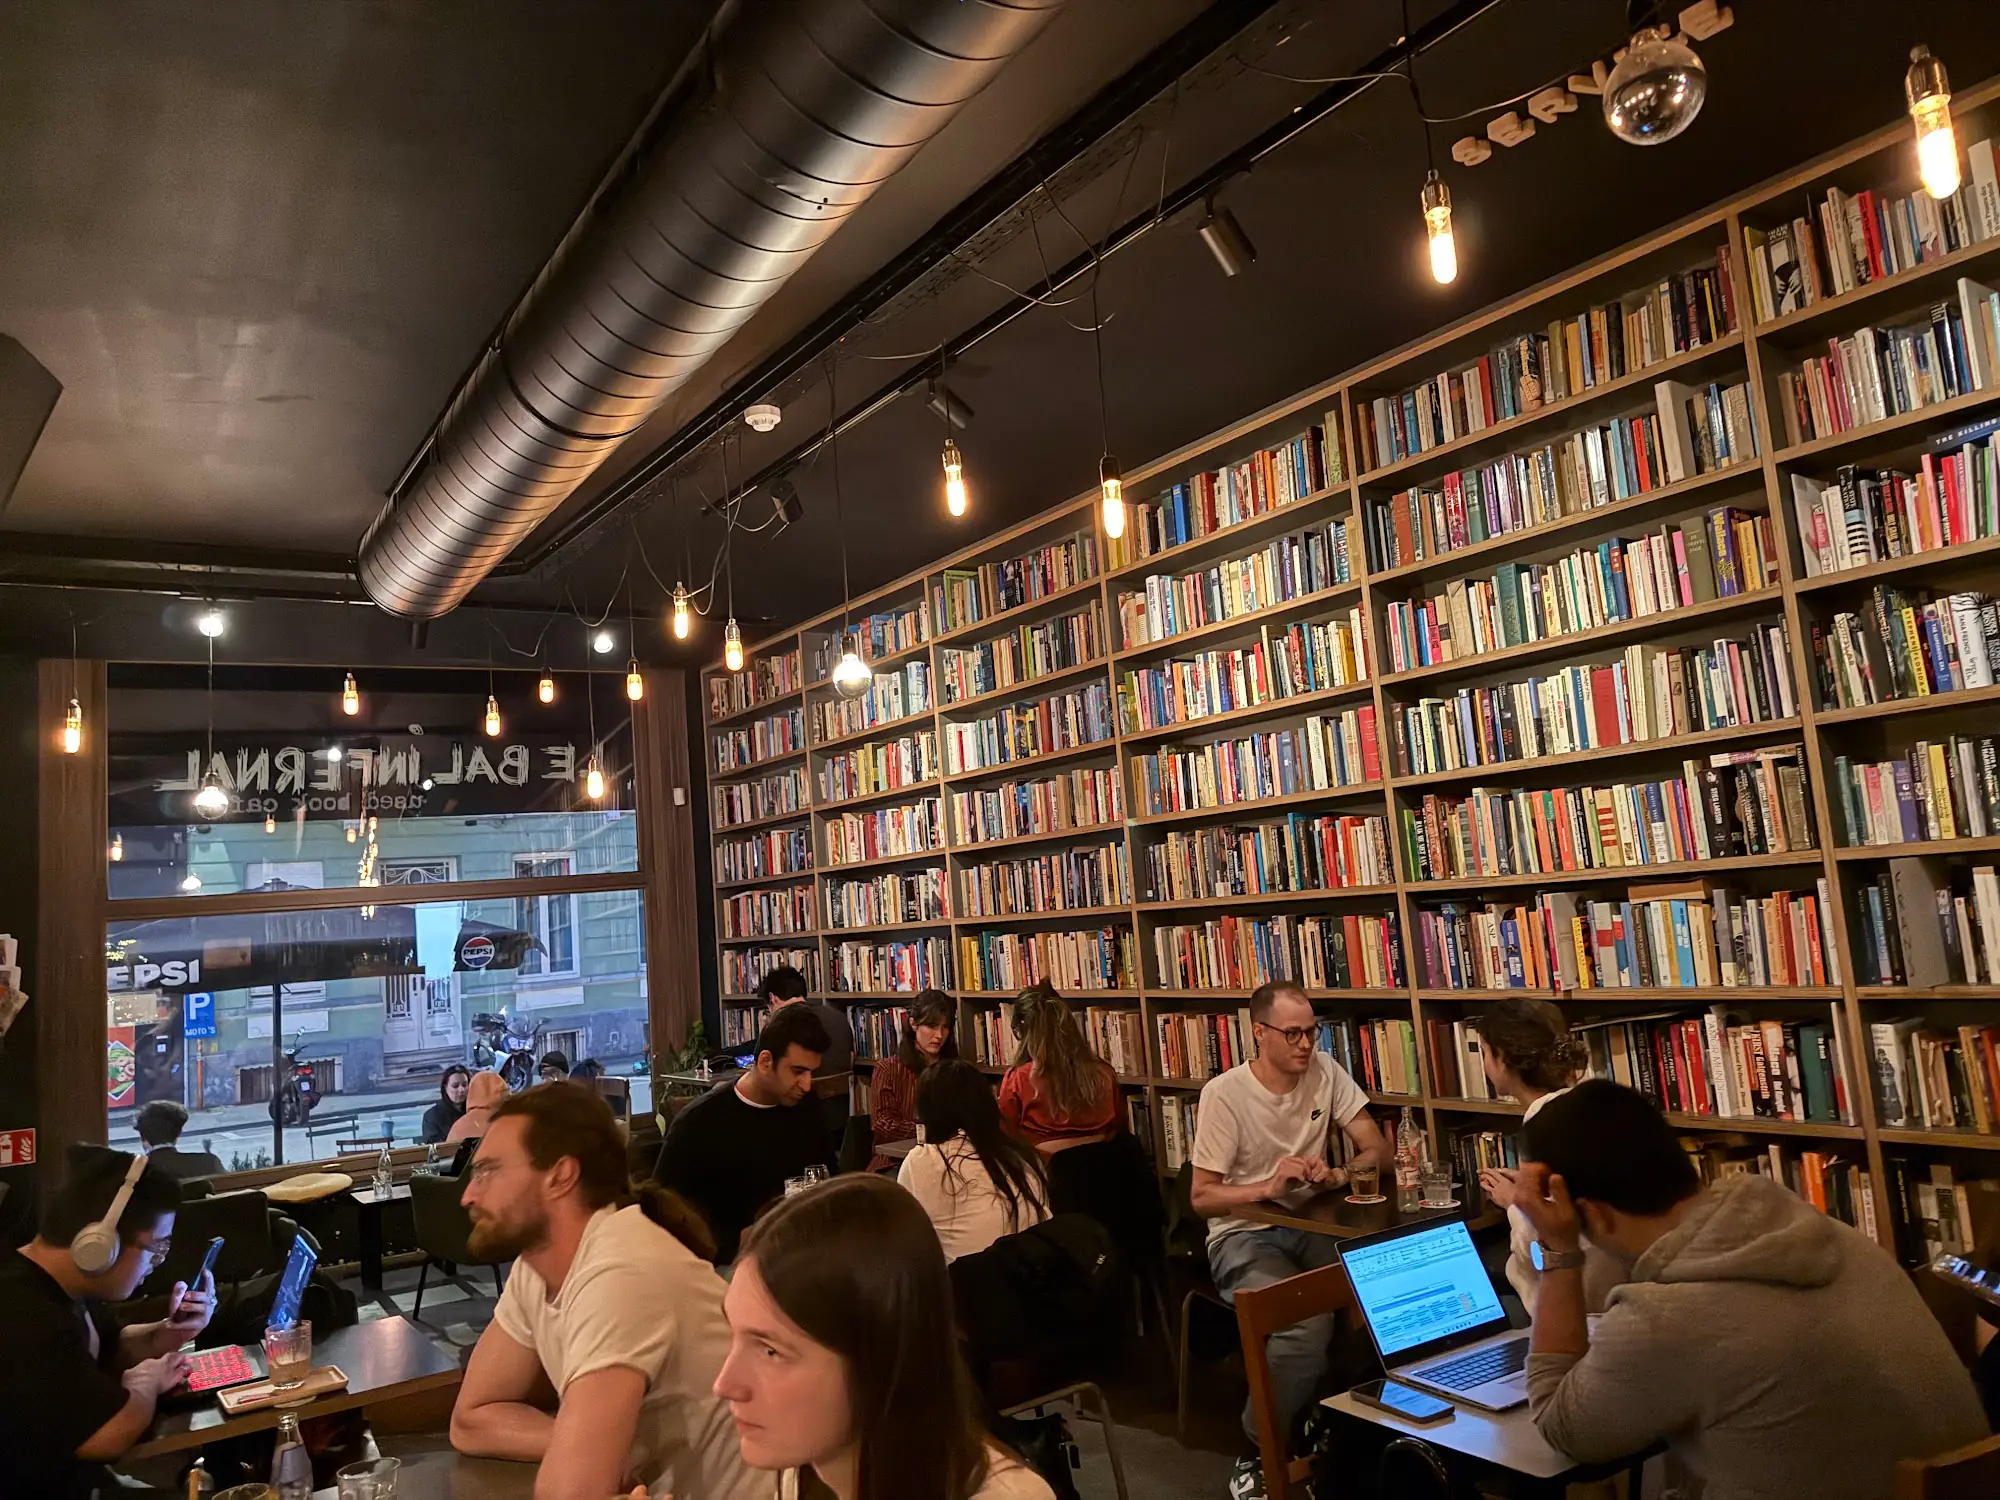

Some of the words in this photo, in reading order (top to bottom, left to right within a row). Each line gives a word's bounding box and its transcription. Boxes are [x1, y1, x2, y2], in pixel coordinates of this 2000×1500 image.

[1957, 418, 1998, 437] KILLING
[1904, 609, 1917, 646] STEPHEN
[1912, 651, 1925, 687] FLORIDA
[1962, 630, 1972, 655] FRENCH
[189, 993, 211, 1020] P
